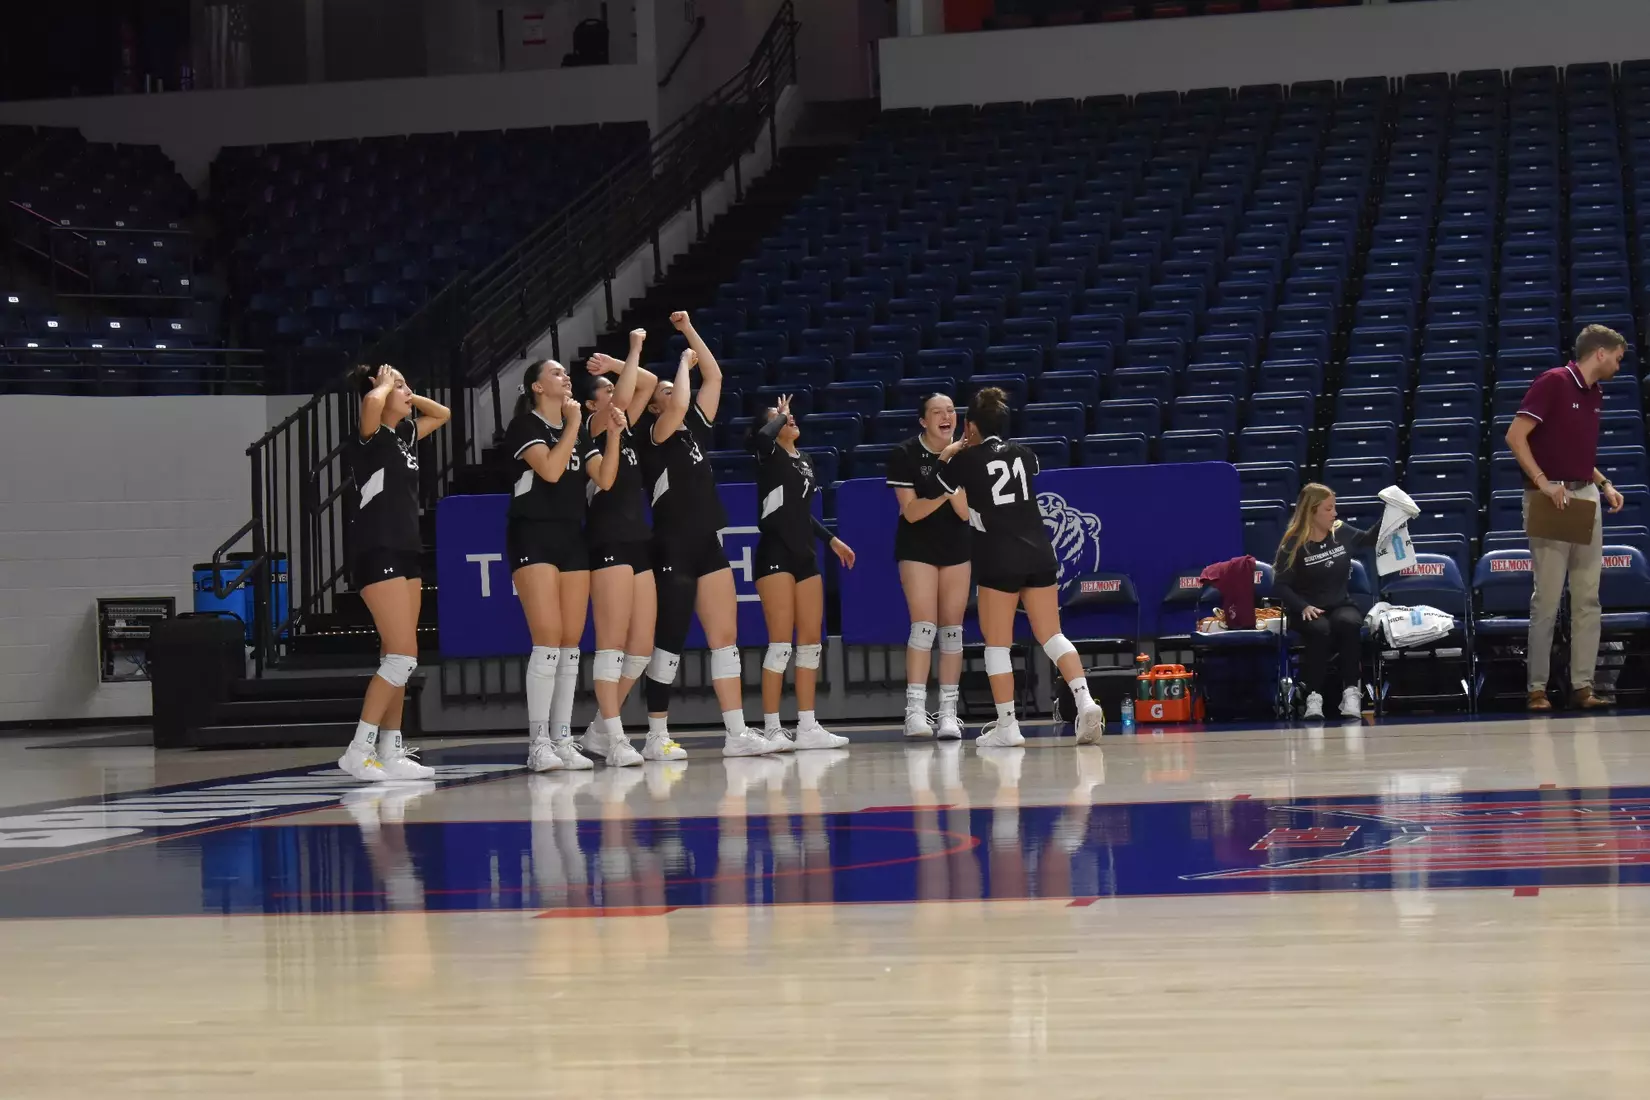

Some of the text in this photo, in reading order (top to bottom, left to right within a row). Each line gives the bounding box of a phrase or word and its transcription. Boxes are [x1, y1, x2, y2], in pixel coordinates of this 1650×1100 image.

[986, 457, 1029, 506] 21
[1490, 559, 1535, 572] BELMONT
[1602, 555, 1632, 568] MONT
[1400, 563, 1445, 576] BELMONT
[1081, 580, 1121, 592] BELMONT
[1151, 704, 1163, 718] G
